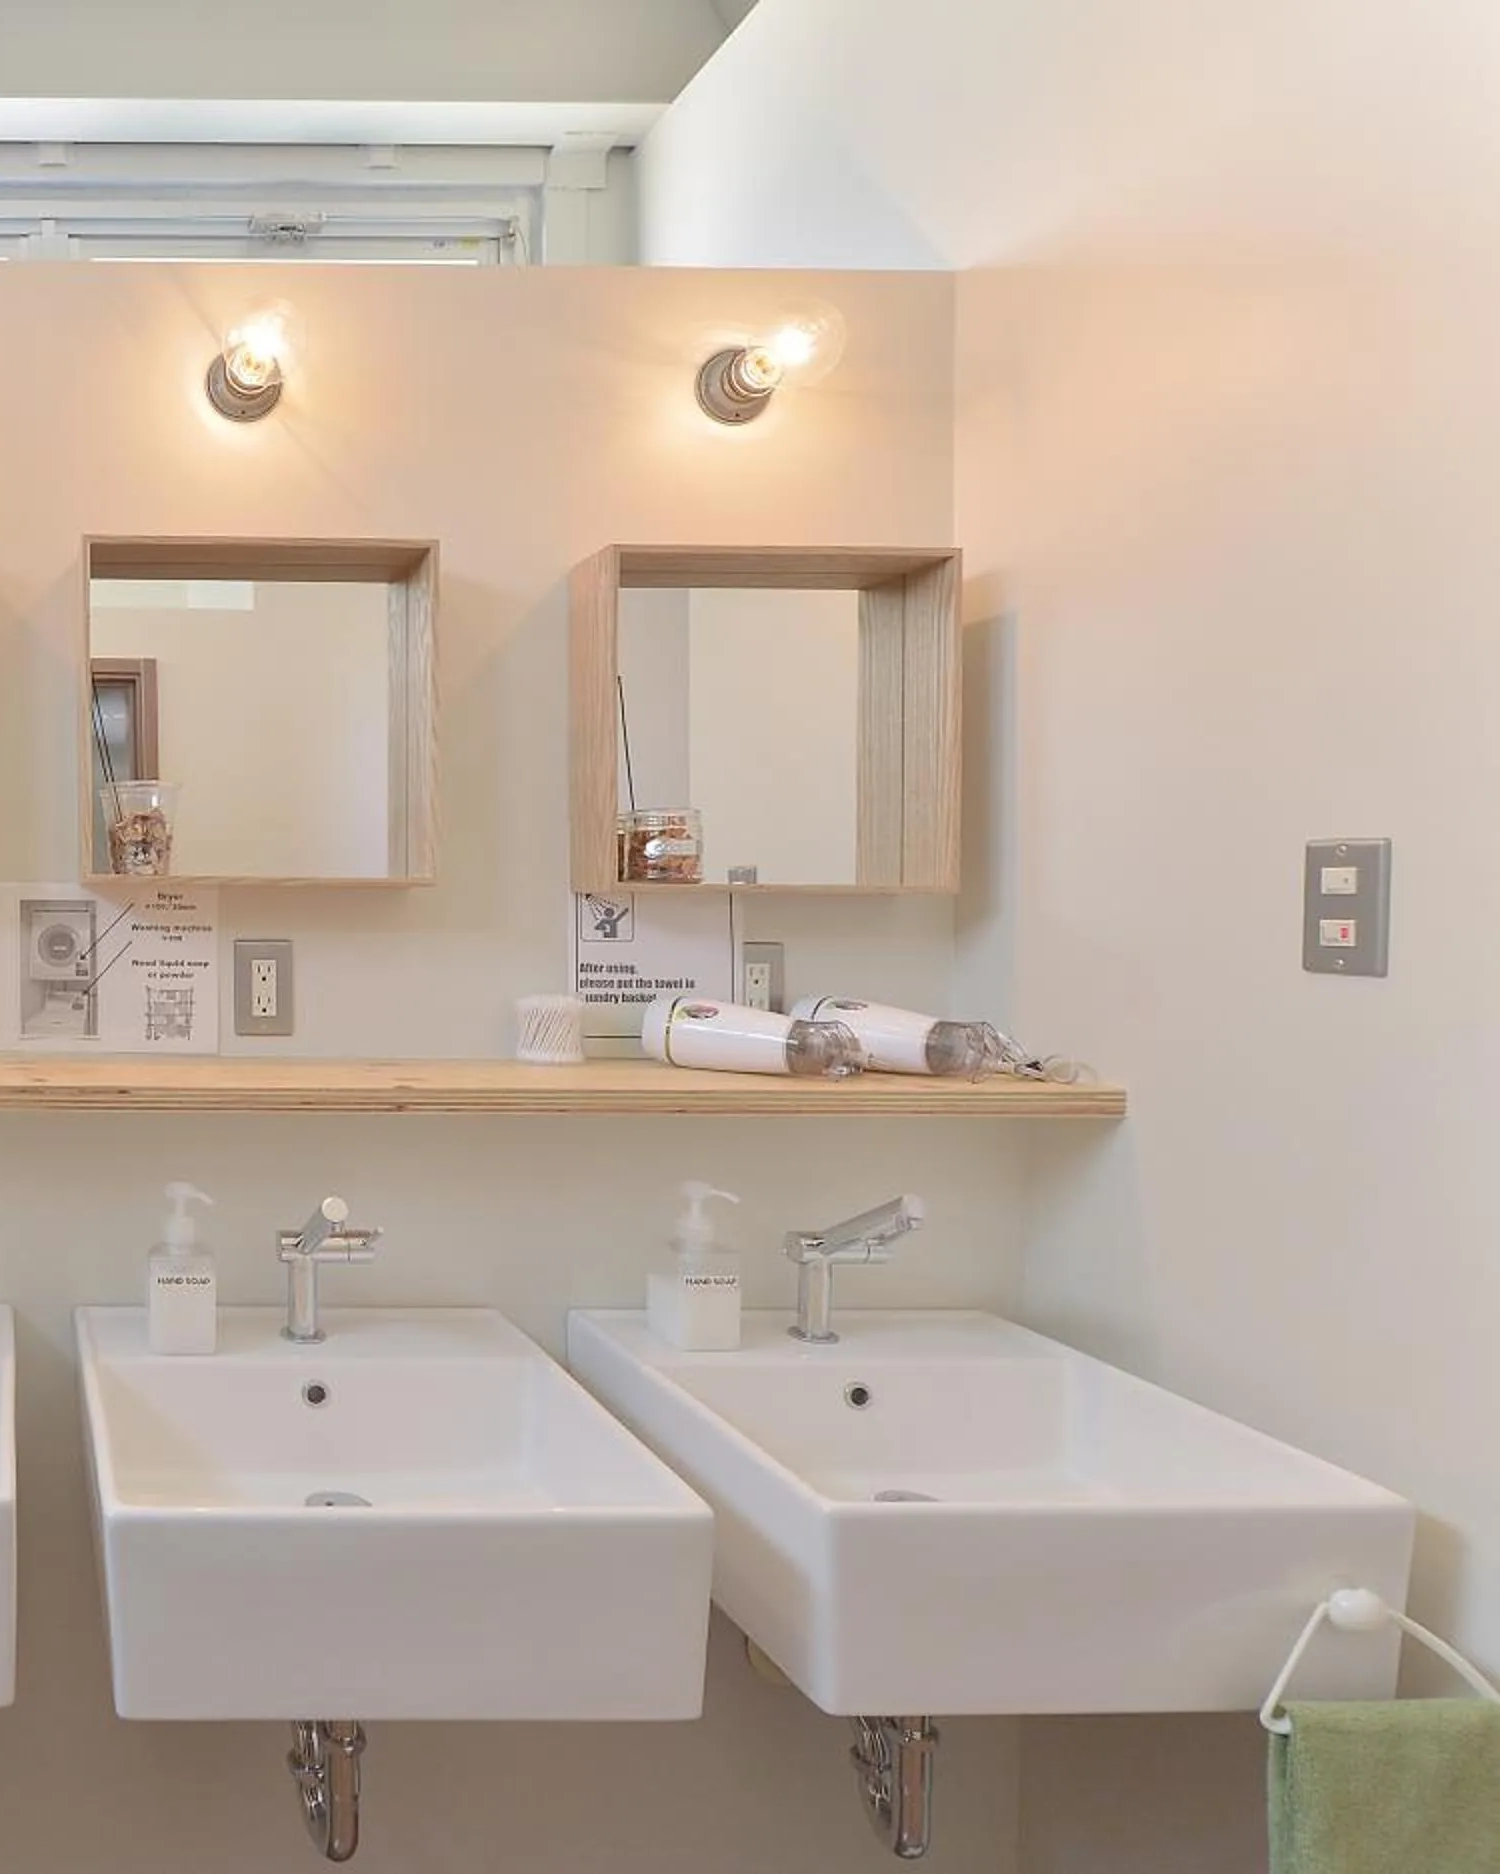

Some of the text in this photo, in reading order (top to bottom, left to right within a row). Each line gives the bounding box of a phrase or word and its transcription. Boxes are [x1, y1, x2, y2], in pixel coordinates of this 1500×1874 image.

[579, 963, 604, 973] After
[579, 978, 614, 989] please
[616, 979, 633, 989] put
[635, 978, 652, 989] the
[654, 978, 683, 989] towel
[157, 1276, 211, 1285] HAND SOAP
